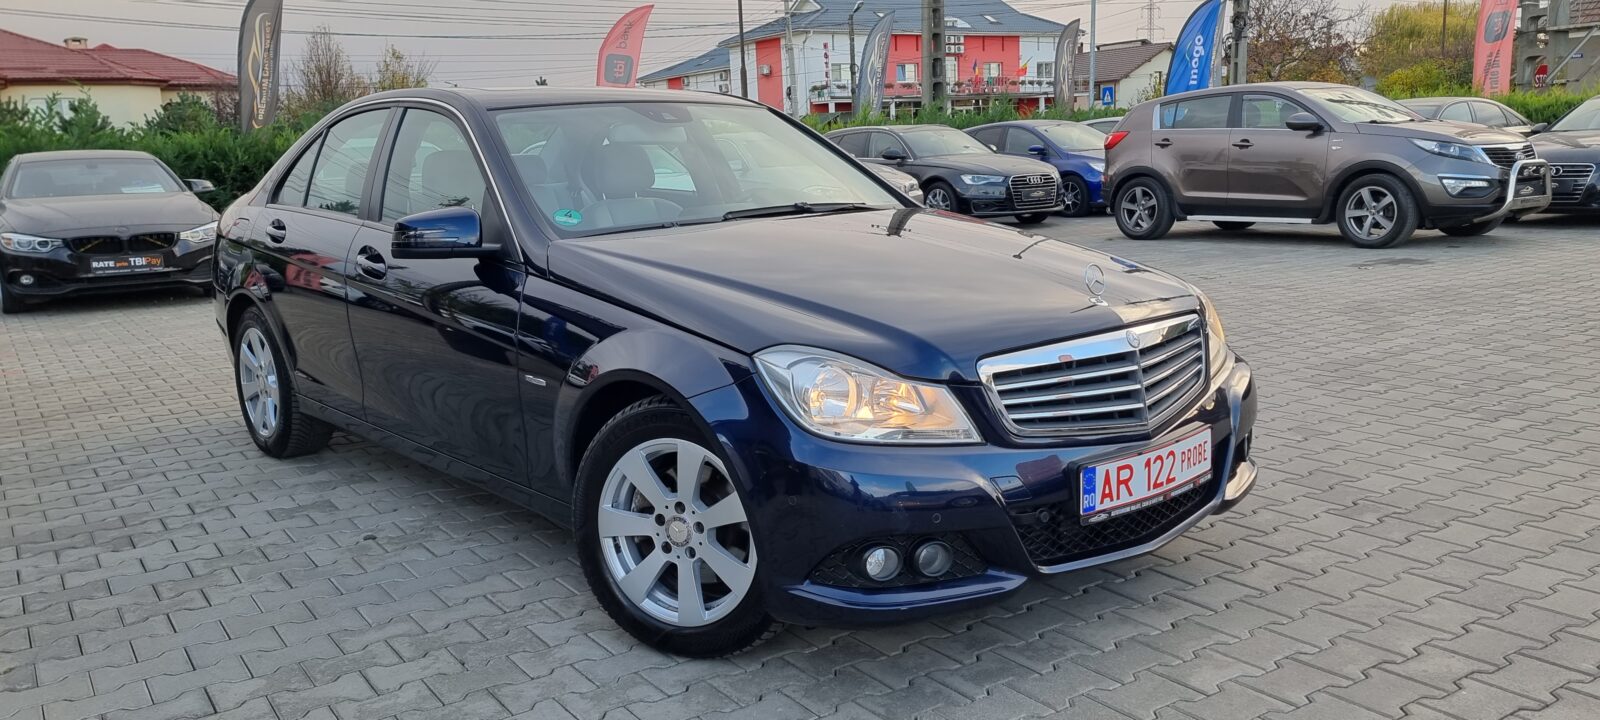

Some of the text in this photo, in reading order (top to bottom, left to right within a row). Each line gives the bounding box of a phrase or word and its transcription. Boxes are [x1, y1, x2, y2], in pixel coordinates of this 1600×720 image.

[613, 20, 633, 79] tbi bank
[1535, 74, 1548, 87] STO
[129, 256, 161, 266] TBIPay
[1100, 441, 1208, 505] AR 122 PROBE
[1083, 493, 1095, 508] RO
